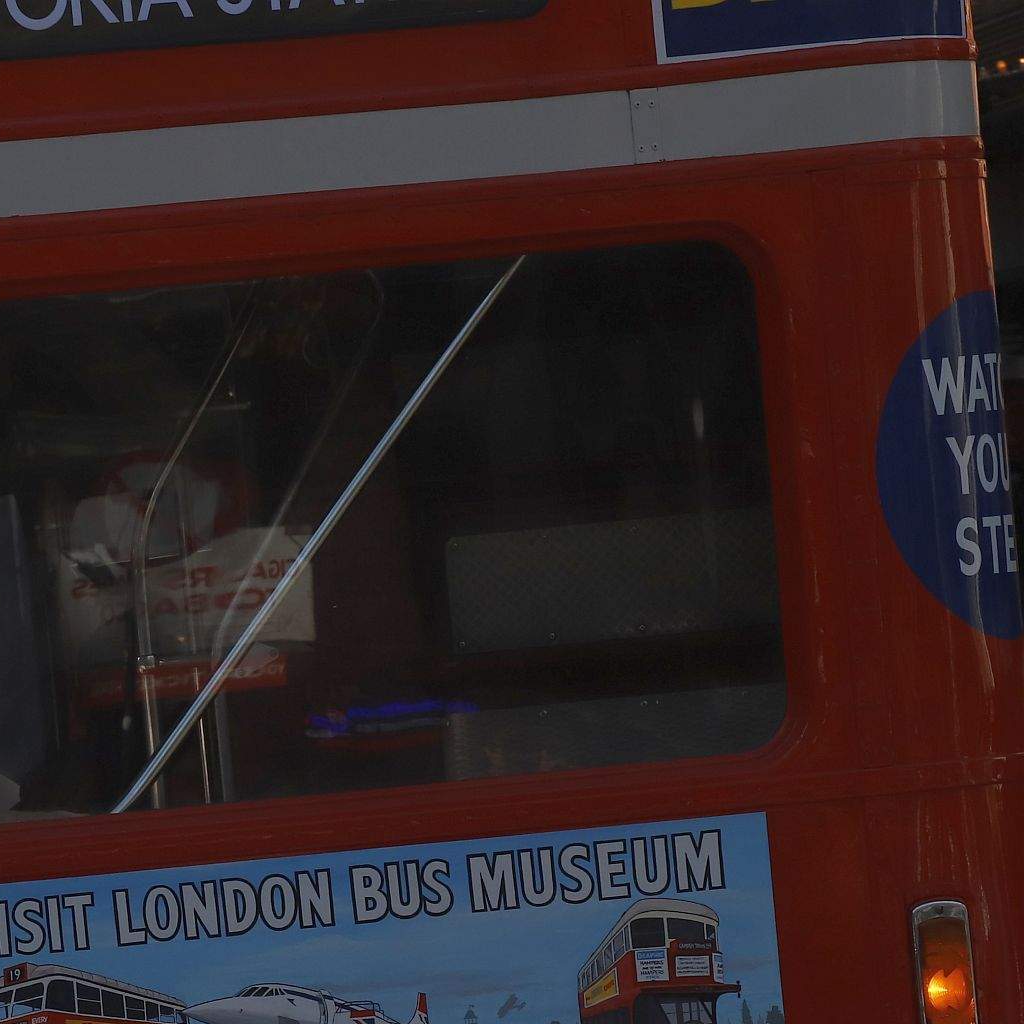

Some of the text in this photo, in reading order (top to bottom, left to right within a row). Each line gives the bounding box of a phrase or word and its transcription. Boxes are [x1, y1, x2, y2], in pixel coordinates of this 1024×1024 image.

[112, 868, 336, 946] LONDON
[349, 858, 454, 925] BUS
[466, 829, 726, 913] MUSEUM
[9, 969, 22, 981] 19
